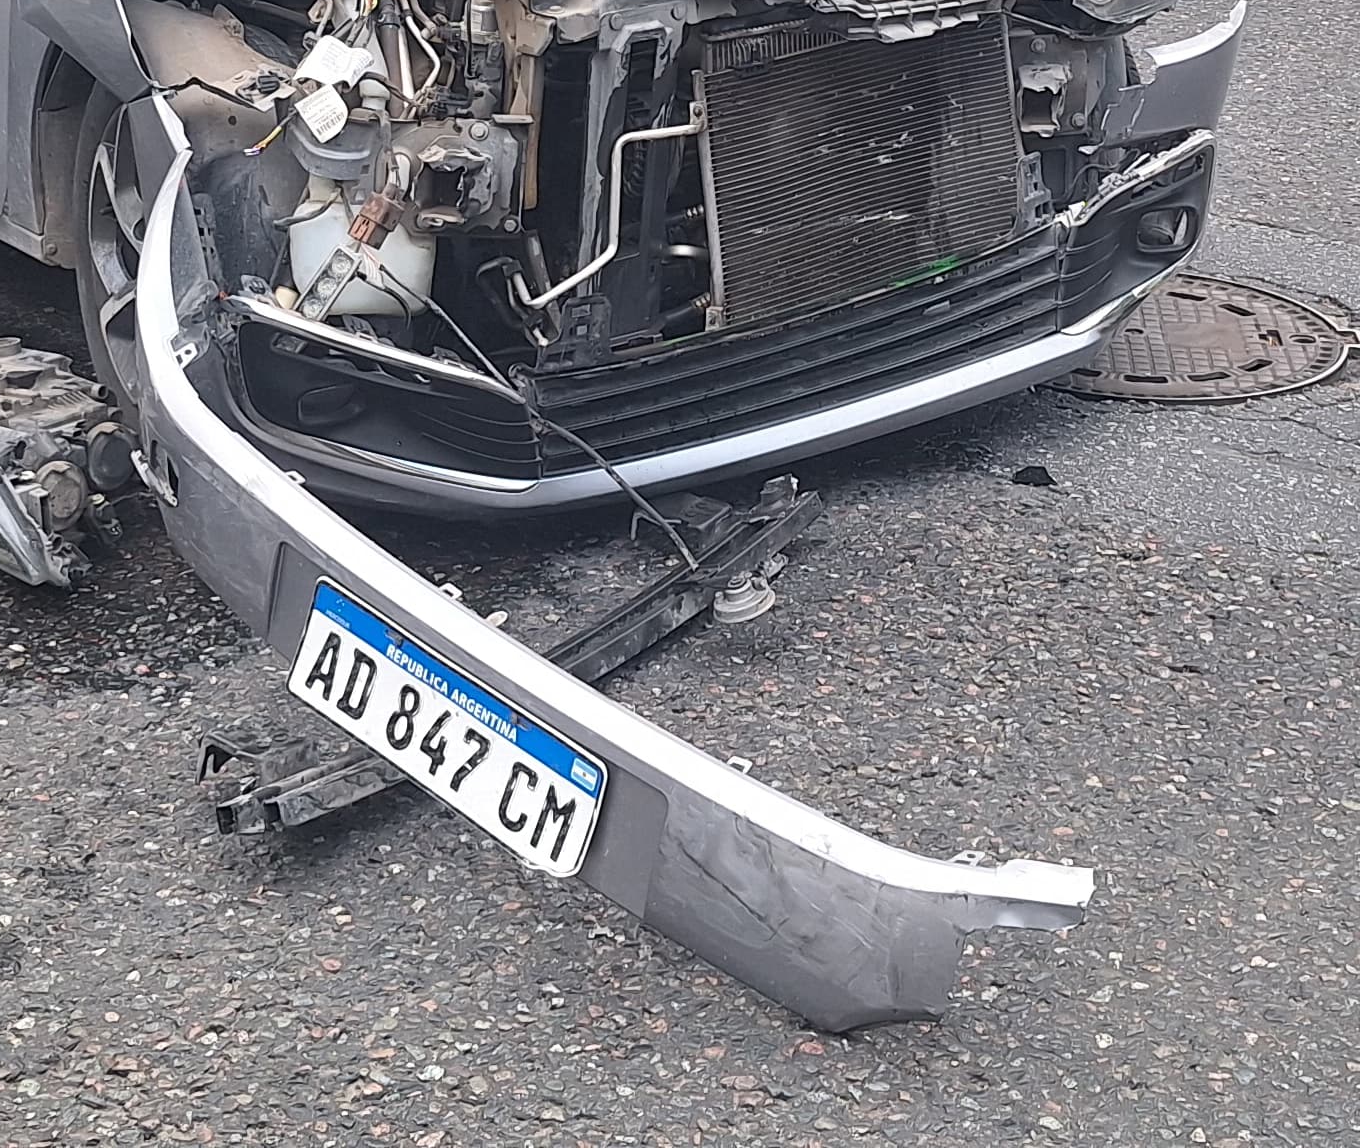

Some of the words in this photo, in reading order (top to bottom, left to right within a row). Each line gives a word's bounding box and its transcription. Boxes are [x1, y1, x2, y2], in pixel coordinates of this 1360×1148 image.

[305, 631, 378, 721] AD
[386, 683, 492, 792] 847
[498, 761, 577, 862] CM
[386, 643, 449, 695] REPUBLICA
[450, 688, 518, 742] ARGENTINA
